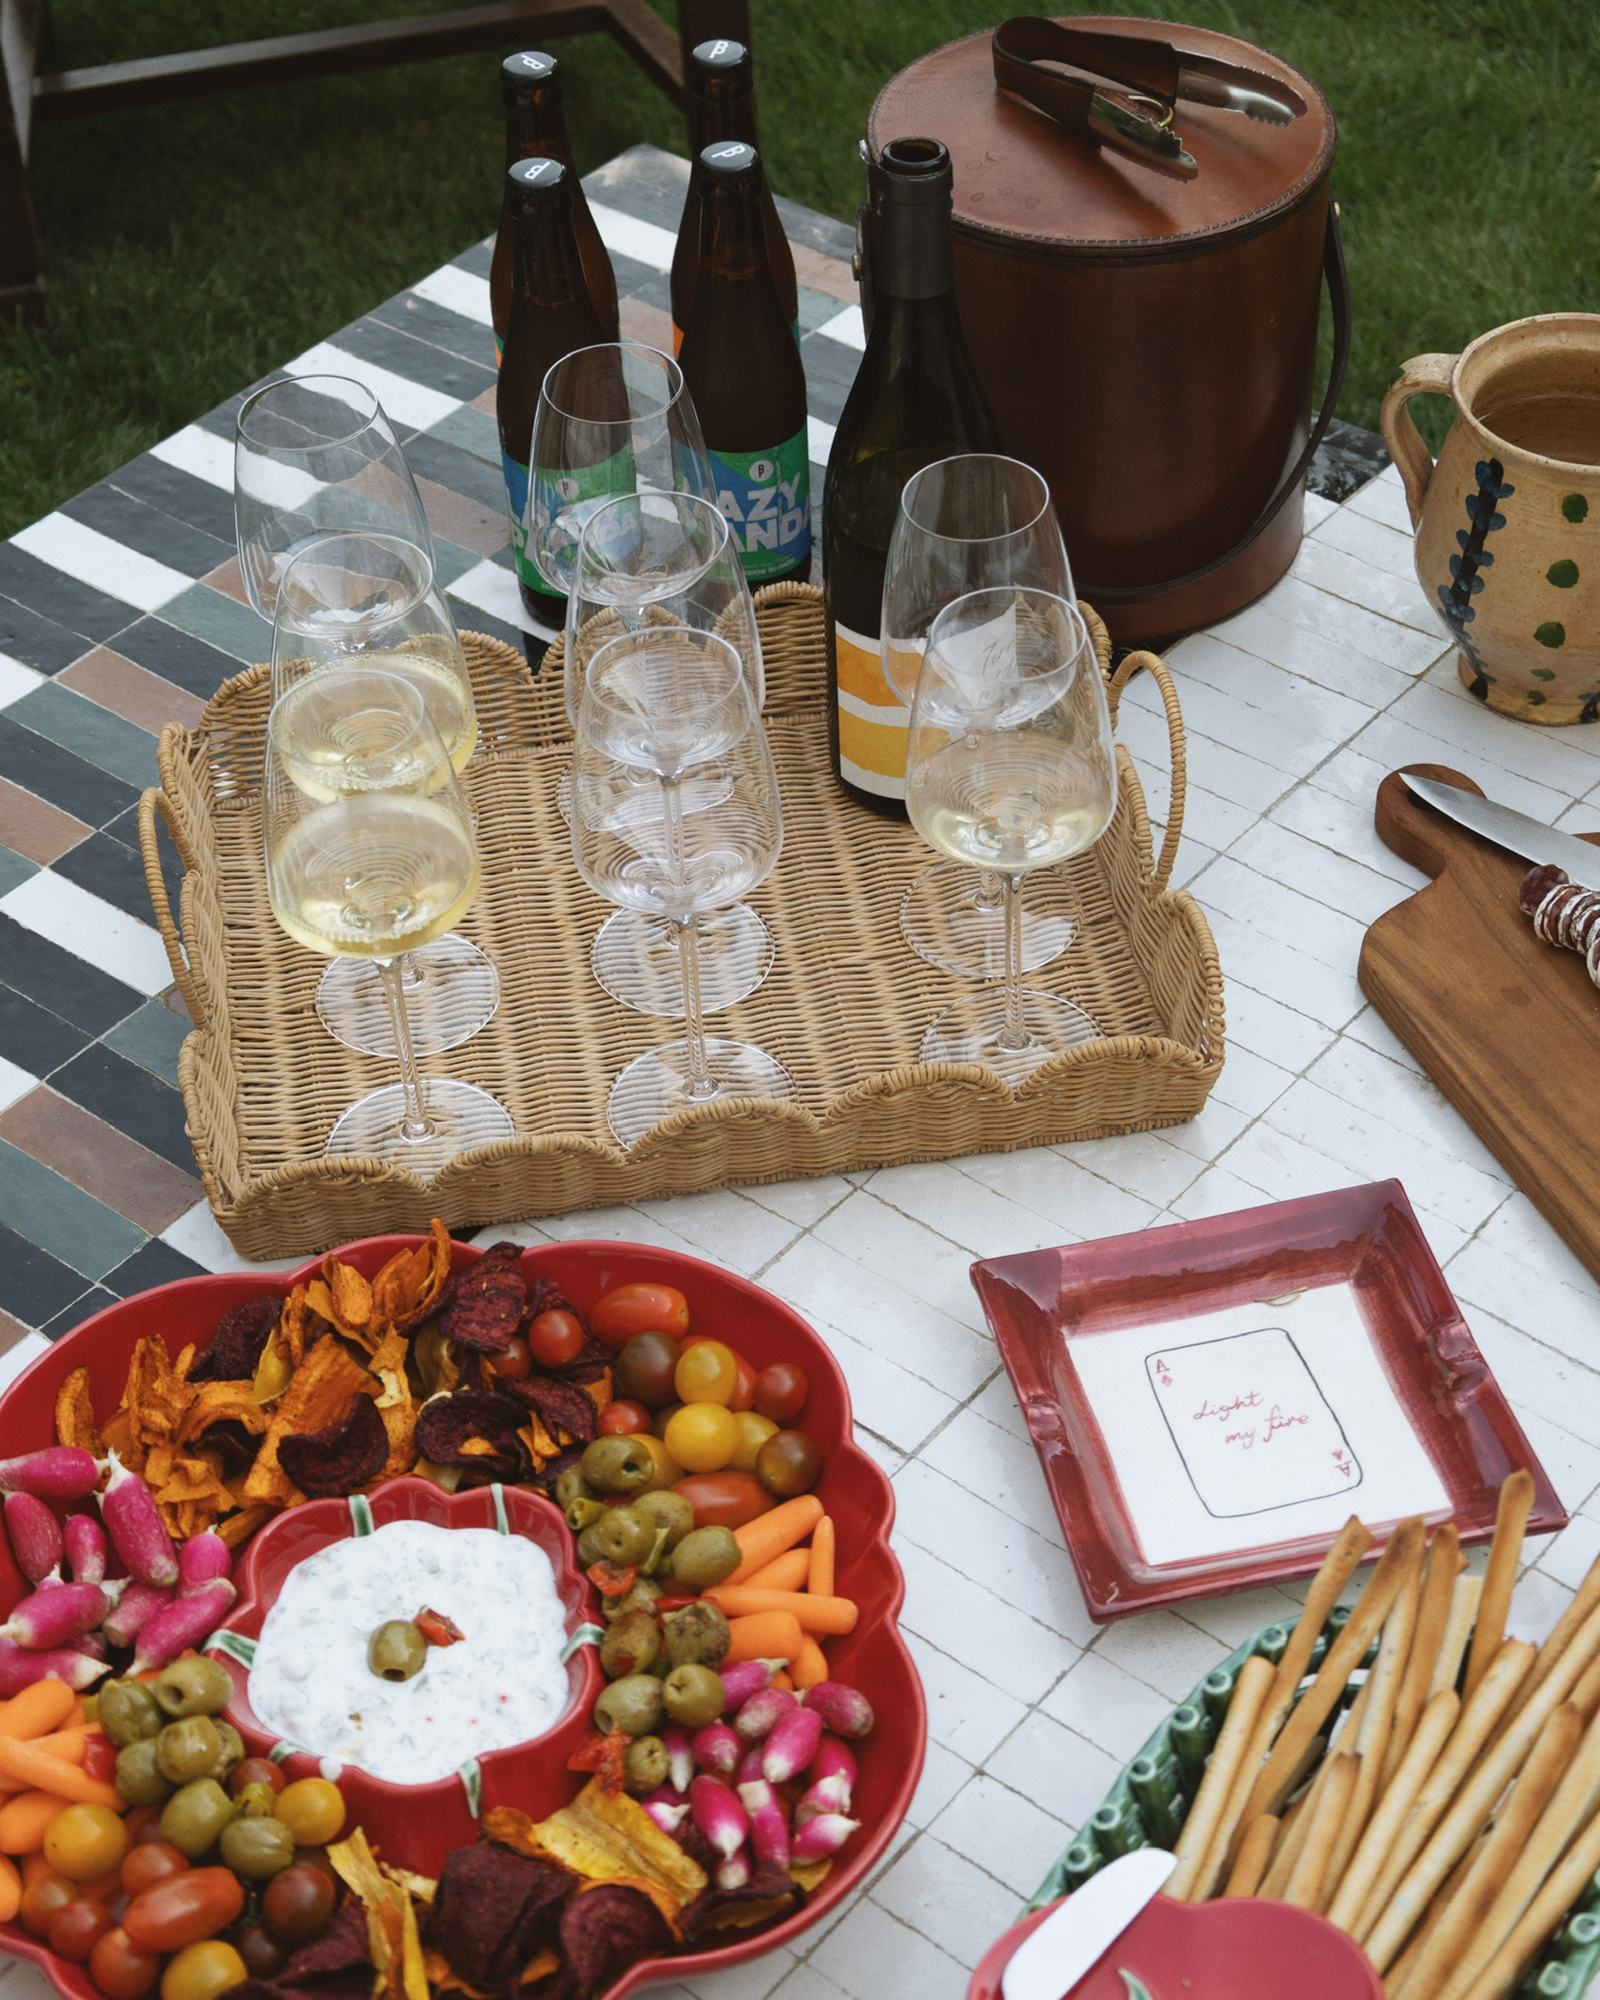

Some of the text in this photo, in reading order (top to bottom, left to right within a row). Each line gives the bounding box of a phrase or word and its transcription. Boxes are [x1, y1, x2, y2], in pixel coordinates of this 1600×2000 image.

[706, 472, 801, 522] AZY
[1155, 1359, 1170, 1374] A
[1193, 1390, 1264, 1421] Light
[1225, 1405, 1309, 1449] my fire
[1335, 1460, 1352, 1477] A
